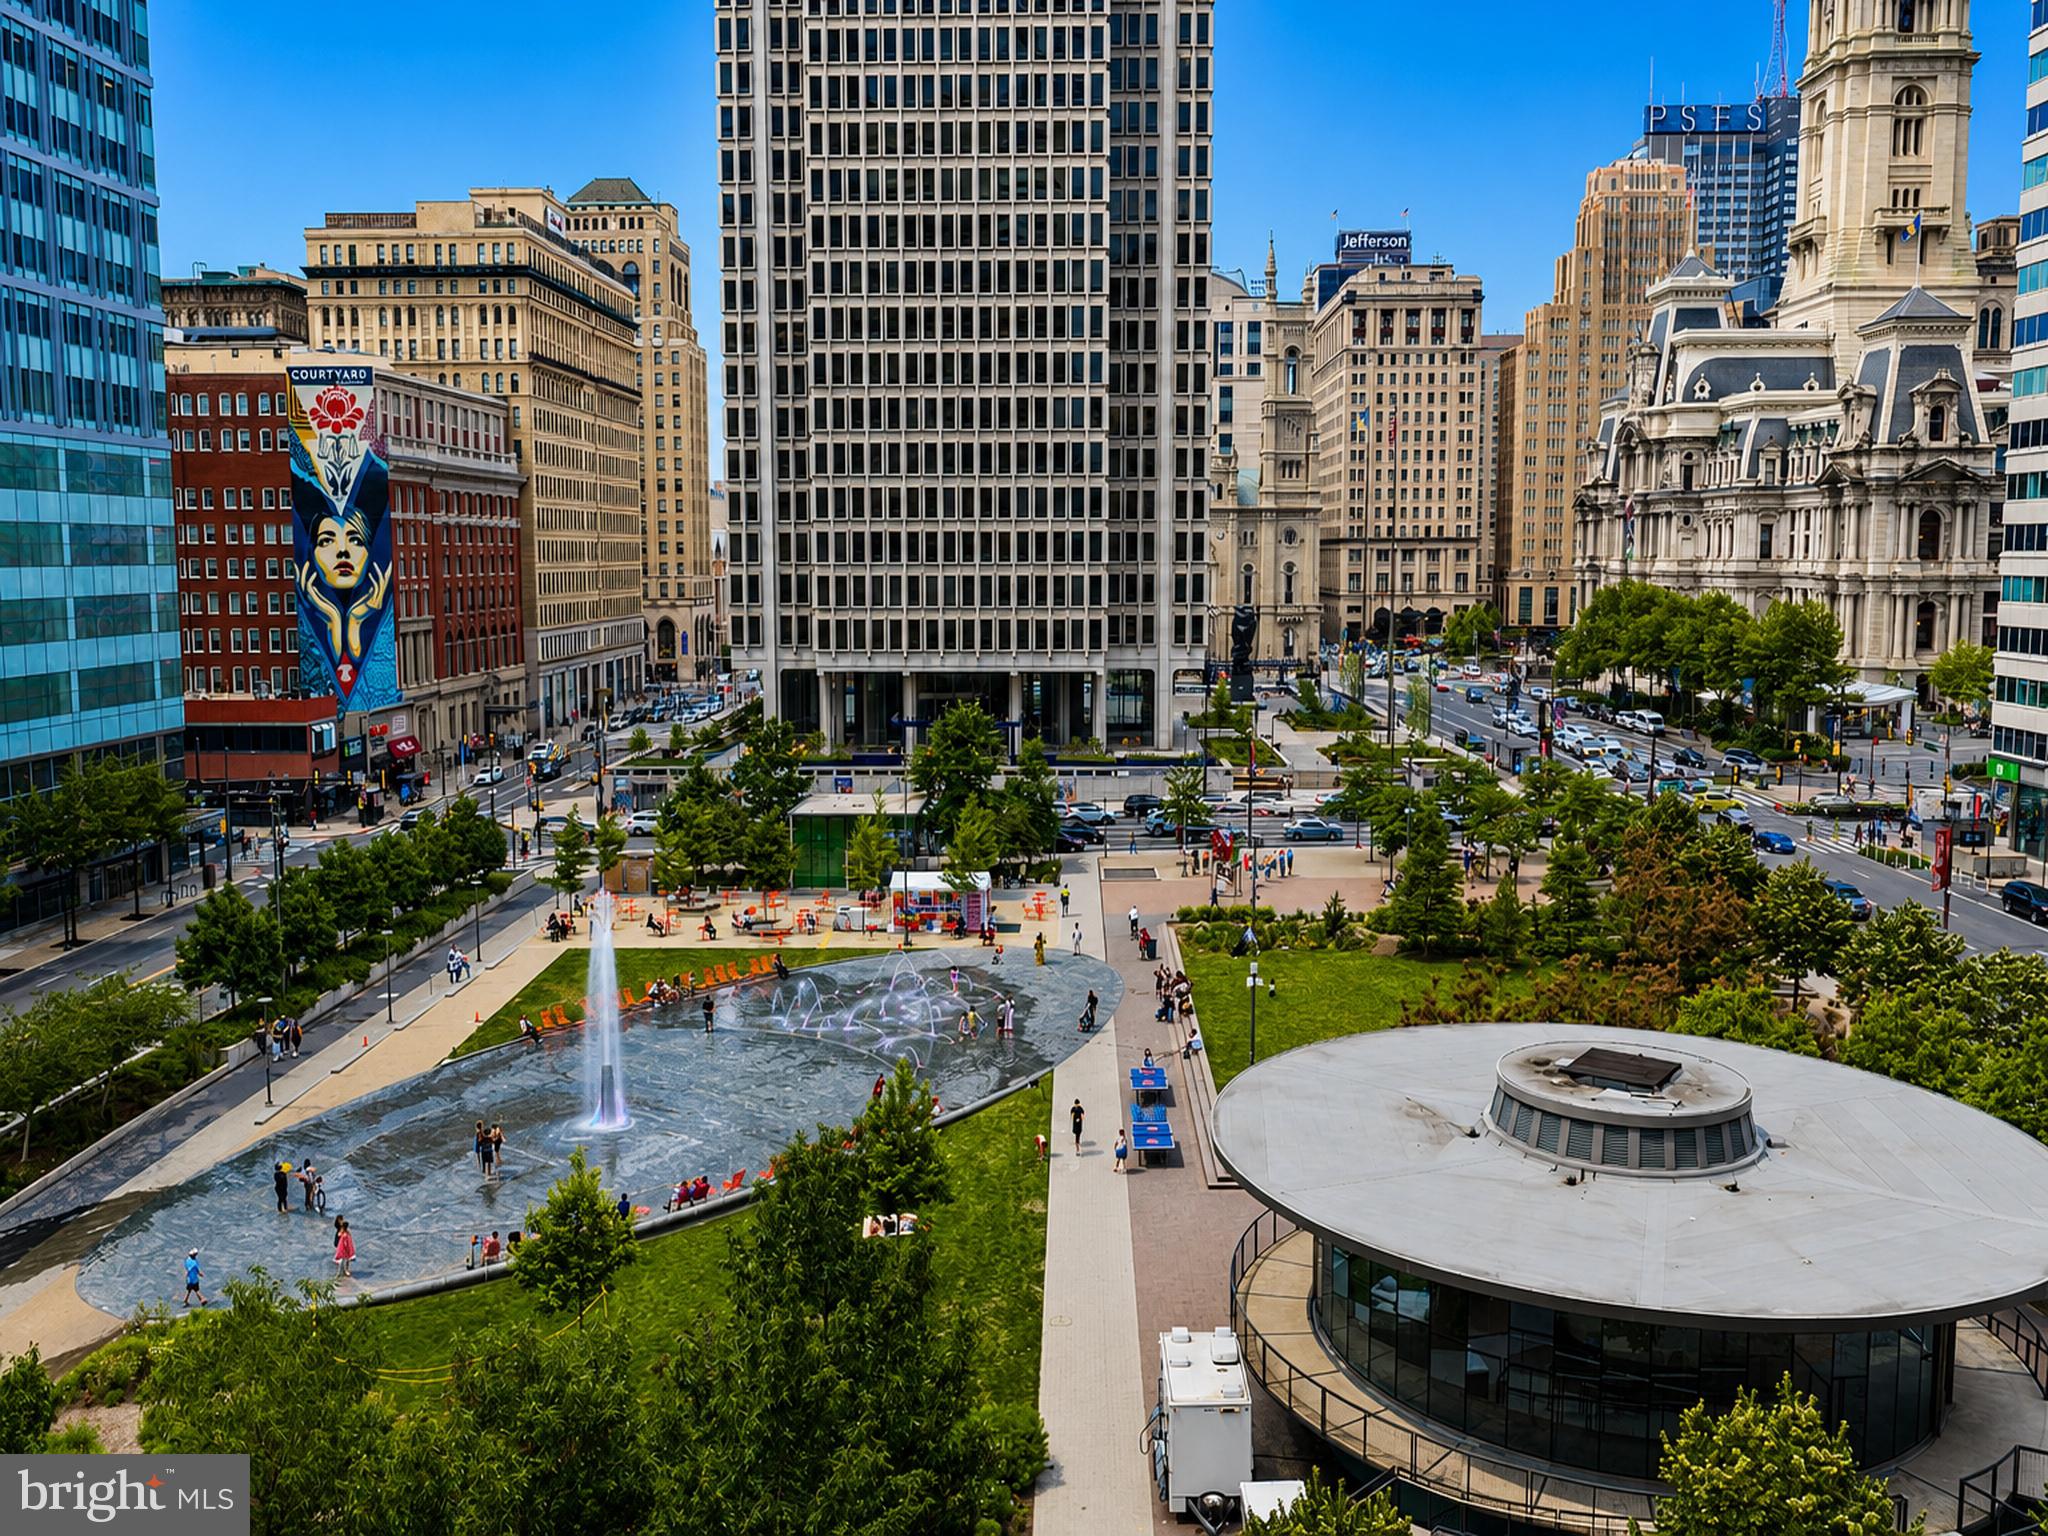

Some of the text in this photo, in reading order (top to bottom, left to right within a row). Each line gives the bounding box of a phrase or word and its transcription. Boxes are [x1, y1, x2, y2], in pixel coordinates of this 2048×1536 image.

[1649, 105, 1762, 133] PSFS
[1342, 233, 1407, 249] Jefferson
[291, 369, 367, 380] COURTYARD
